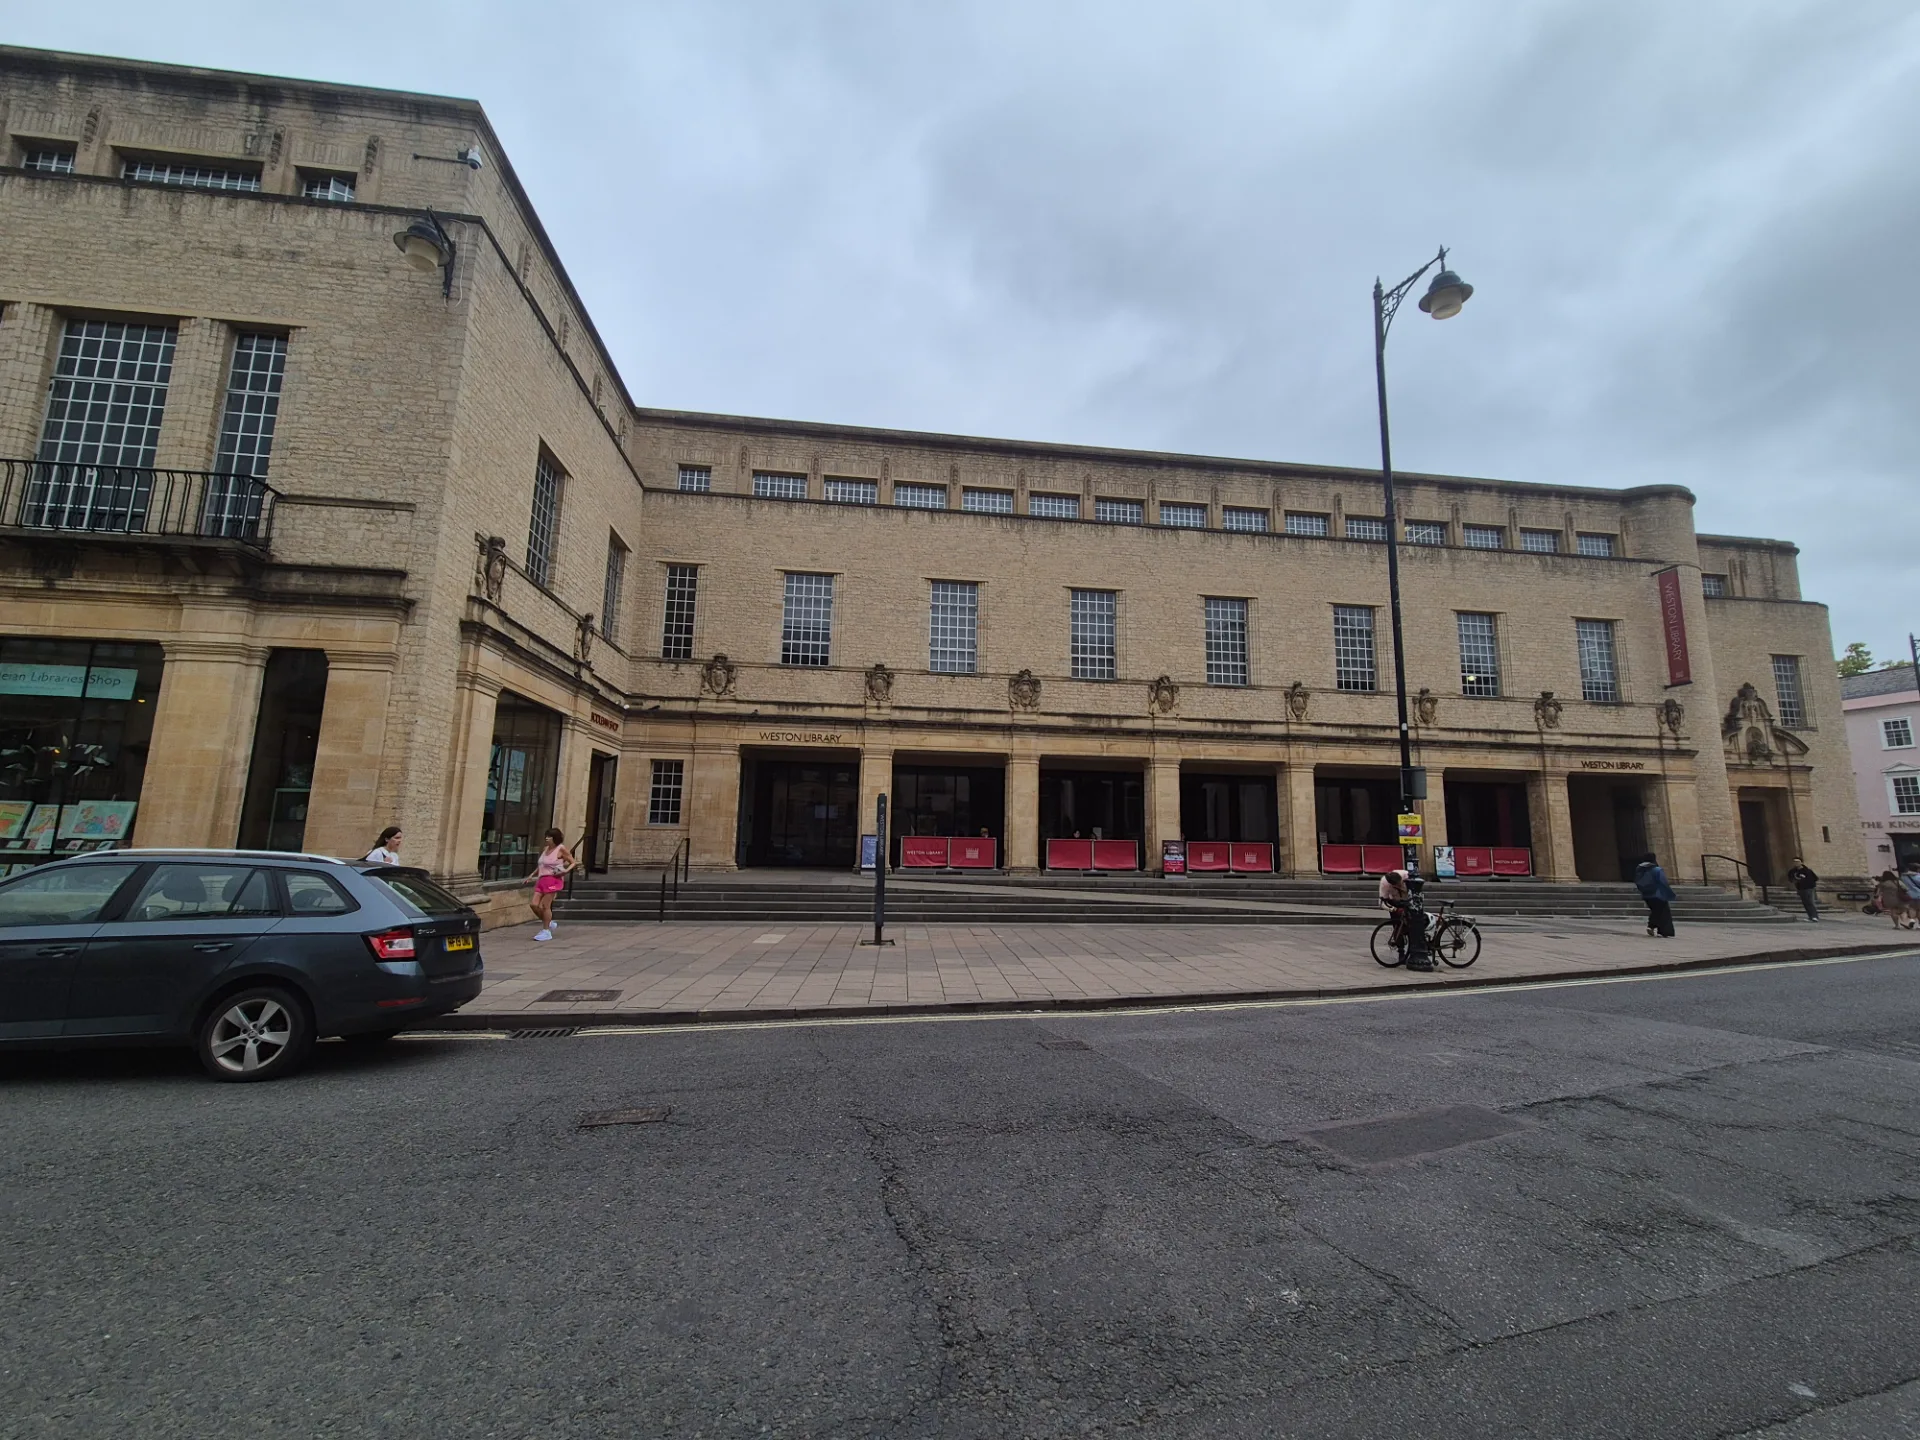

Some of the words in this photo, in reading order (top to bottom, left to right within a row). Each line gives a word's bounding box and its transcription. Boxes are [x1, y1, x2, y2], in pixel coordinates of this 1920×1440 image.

[1664, 582, 1678, 624] WESTON
[1669, 625, 1682, 661] LIBRARY
[0, 671, 26, 682] eian
[30, 671, 84, 684] Libraries
[88, 674, 121, 688] Shop
[759, 731, 802, 742] WESTON
[803, 733, 842, 744] LIBRARY
[1581, 760, 1615, 769] WESTON
[1615, 761, 1645, 770] LIBRARY
[1861, 821, 1884, 829] THE
